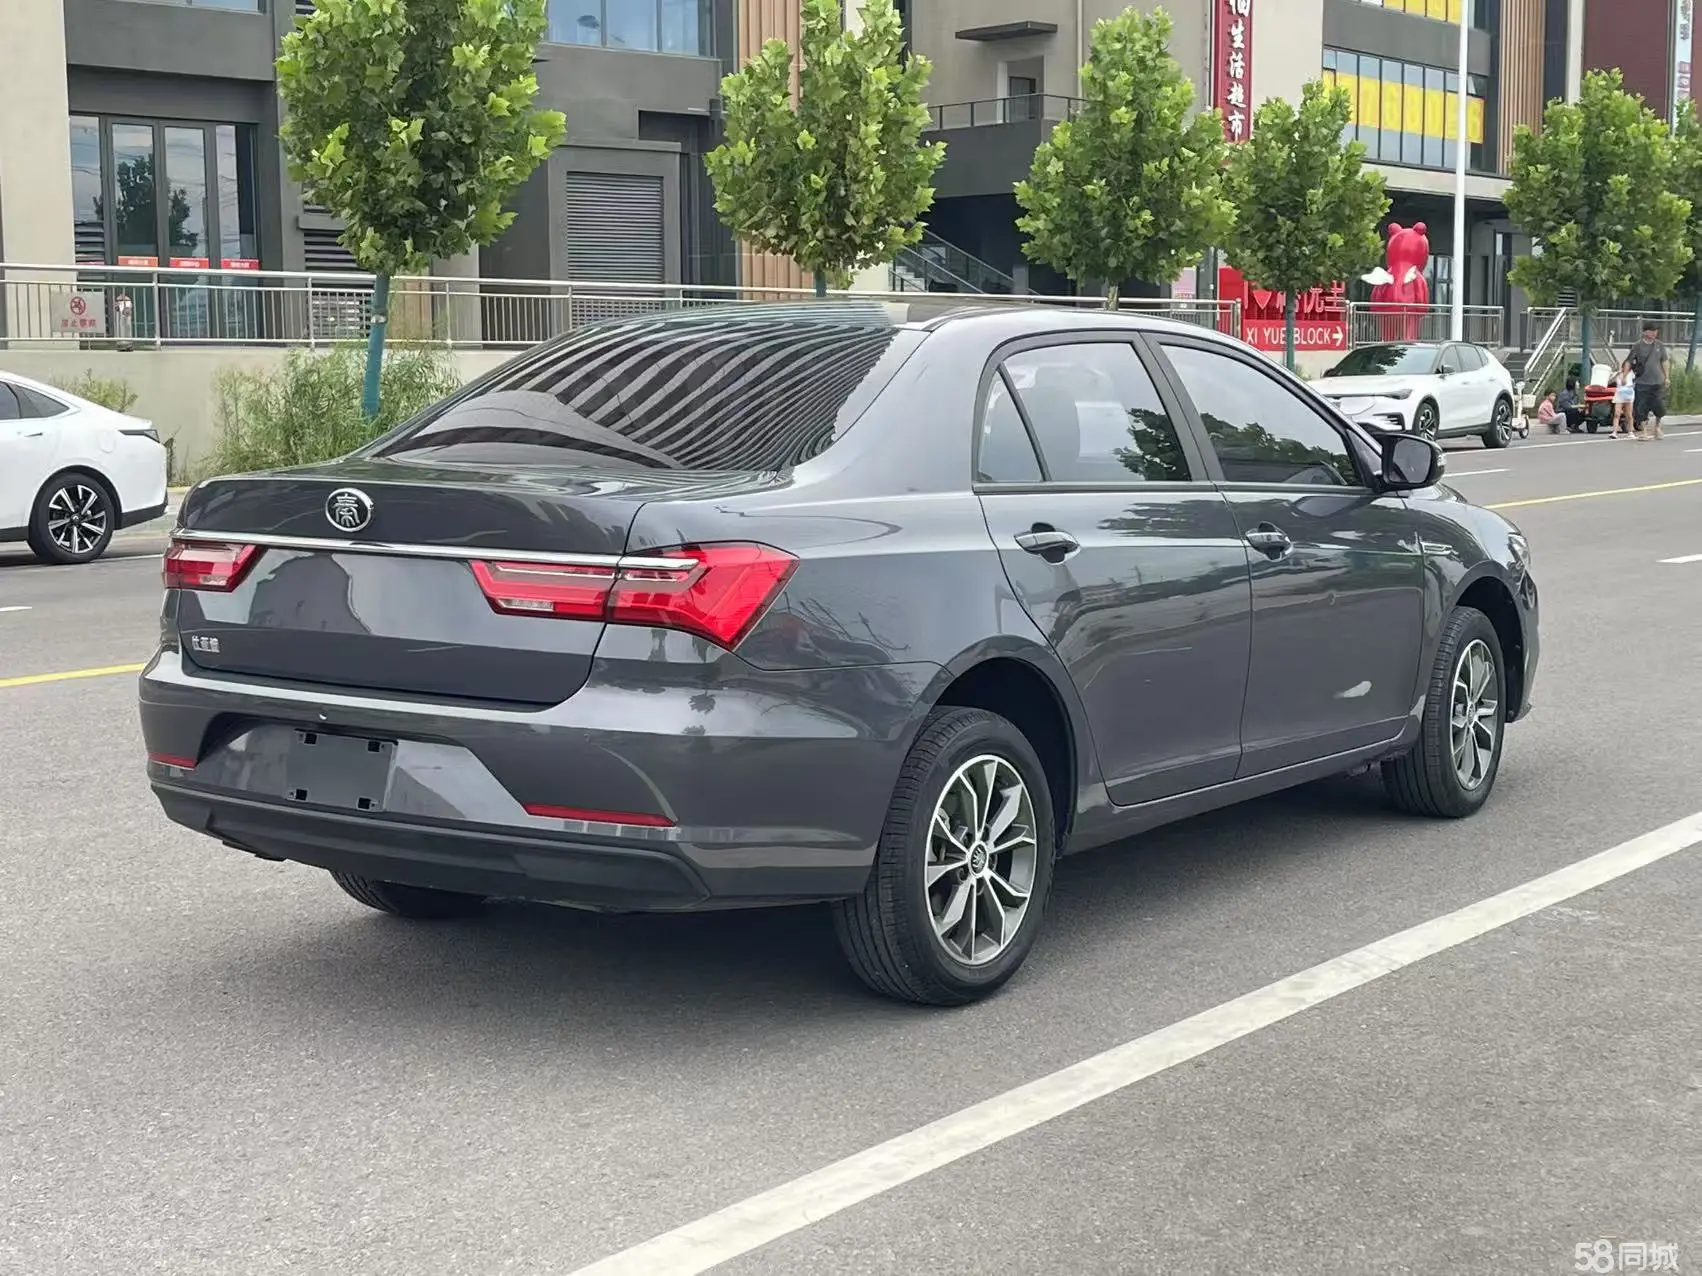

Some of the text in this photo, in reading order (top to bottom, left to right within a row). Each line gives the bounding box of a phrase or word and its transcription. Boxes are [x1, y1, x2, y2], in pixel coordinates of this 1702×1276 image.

[1246, 327, 1331, 345] XI YUE BLOCK
